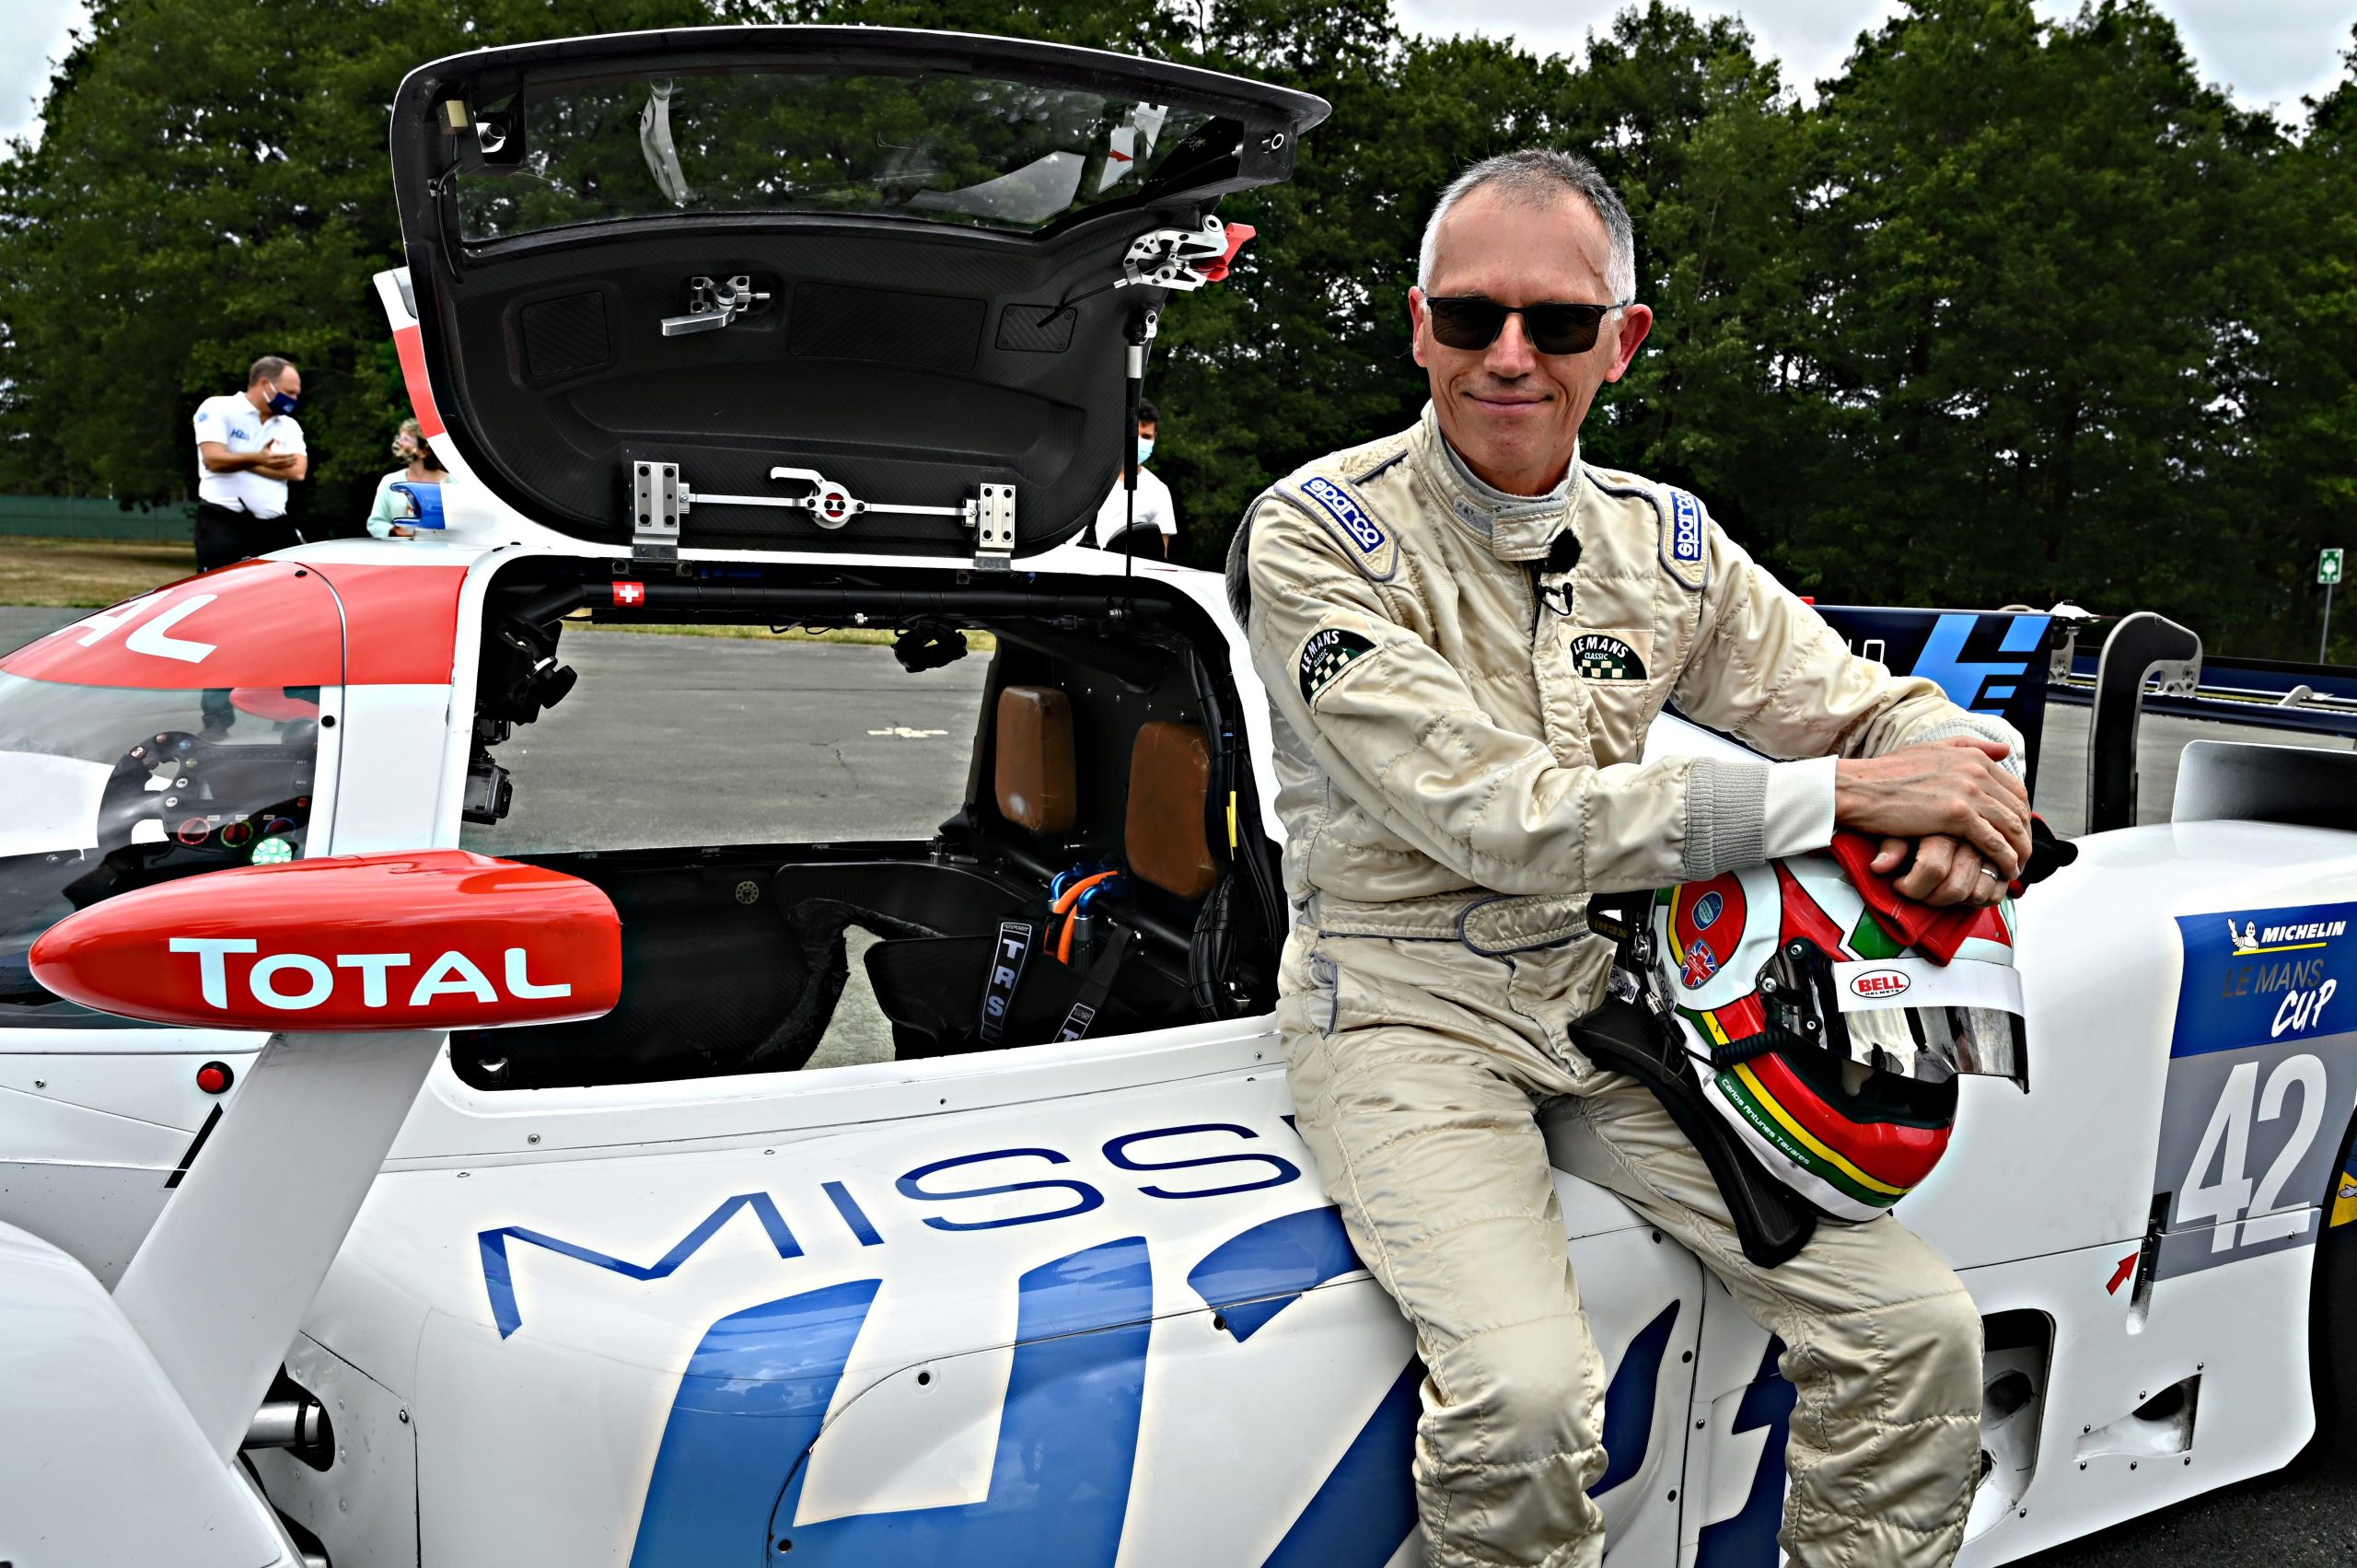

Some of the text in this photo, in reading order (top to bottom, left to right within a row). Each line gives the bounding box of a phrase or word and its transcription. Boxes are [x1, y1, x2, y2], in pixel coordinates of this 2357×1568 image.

[1306, 479, 1379, 547] sparco
[1301, 630, 1340, 673] LE MANS
[1573, 636, 1629, 658] LE MANS
[1585, 652, 1608, 660] CLASSIC
[2261, 921, 2346, 943] MICHELIN
[169, 937, 572, 1010] TOTAL
[1858, 976, 1904, 993] BELL
[2222, 958, 2324, 997] LE MANS
[2270, 979, 2337, 1038] CUP
[1722, 1078, 1810, 1165] Carlos Antunes Tavares
[2176, 1053, 2327, 1254] 42
[478, 1115, 1306, 1341] MISS
